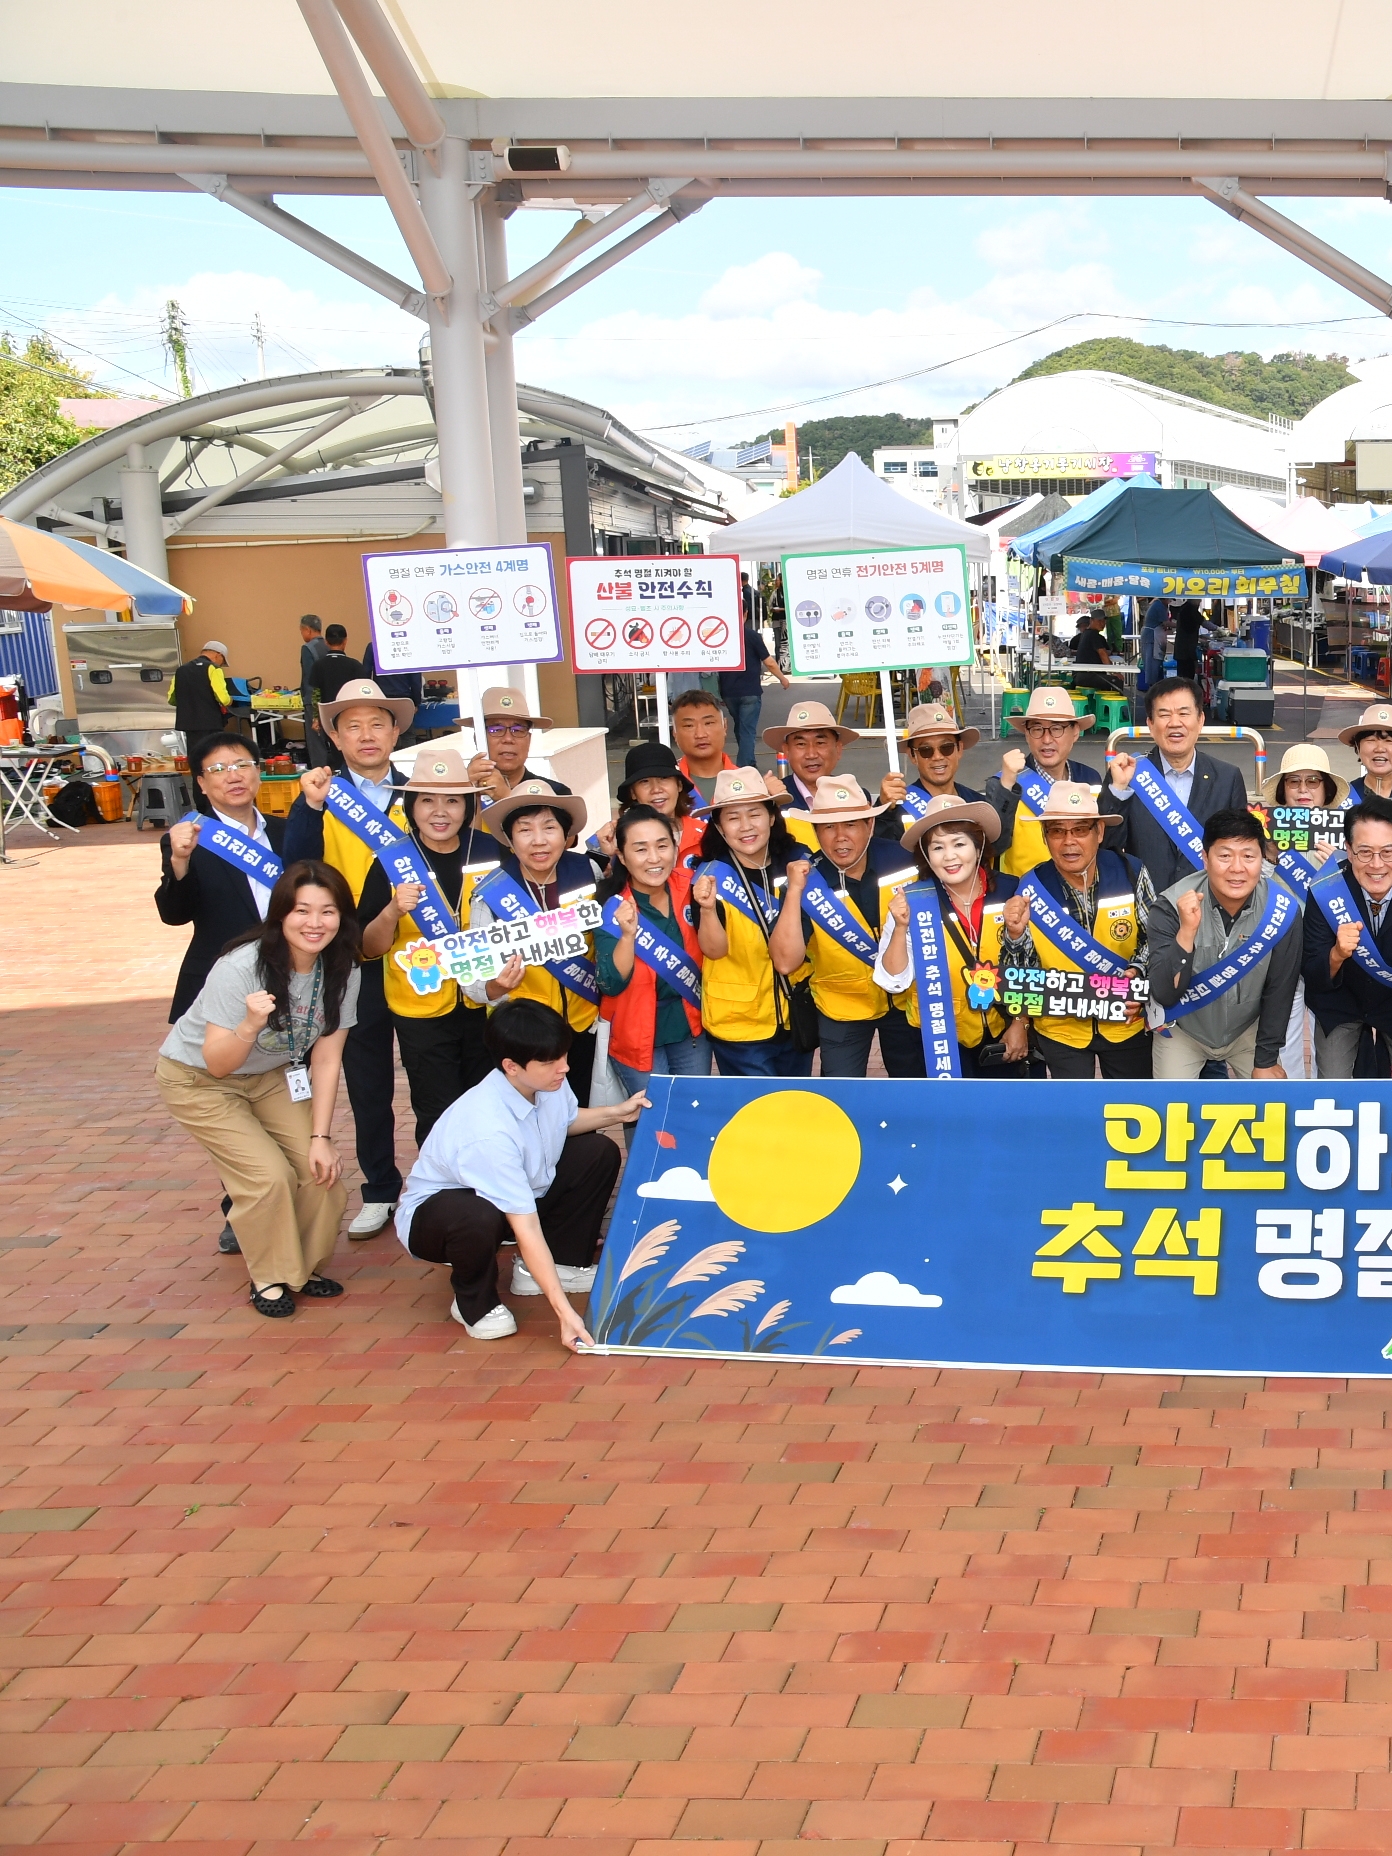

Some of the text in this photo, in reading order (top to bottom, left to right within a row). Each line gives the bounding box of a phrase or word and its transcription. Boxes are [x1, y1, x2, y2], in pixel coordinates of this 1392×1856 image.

[389, 559, 529, 579] 명절 연휴 가스안전 4계명
[614, 567, 692, 578] 추석 명절 지켜야 할
[806, 560, 944, 580] 명절 연휴 전기안전 5계명
[597, 580, 712, 600] 산불 안전수칙
[1163, 576, 1229, 595] 가오리
[1235, 574, 1300, 595] 회무침
[1137, 770, 1193, 837] 안전한 추석
[1273, 807, 1345, 828] 안전하고
[212, 829, 262, 867] 안전한
[1273, 829, 1309, 850] 명절
[421, 905, 449, 936] 추석
[444, 920, 532, 959] 안전하고
[534, 903, 600, 936] 행복한
[807, 888, 872, 954] 안전한 추석
[1262, 893, 1289, 940] 안전한
[1057, 926, 1088, 952] 추석
[450, 954, 496, 983] 명절
[500, 933, 585, 965] 보내세요
[653, 944, 682, 972] 추석
[1236, 942, 1264, 967] 추석
[916, 911, 947, 1035] 안전한 추석 명절
[1004, 966, 1149, 1001] 안전하고 행복한
[1208, 965, 1238, 988] 명절
[1003, 991, 1127, 1021] 명절 보내세요
[1029, 1202, 1223, 1297] 추석
